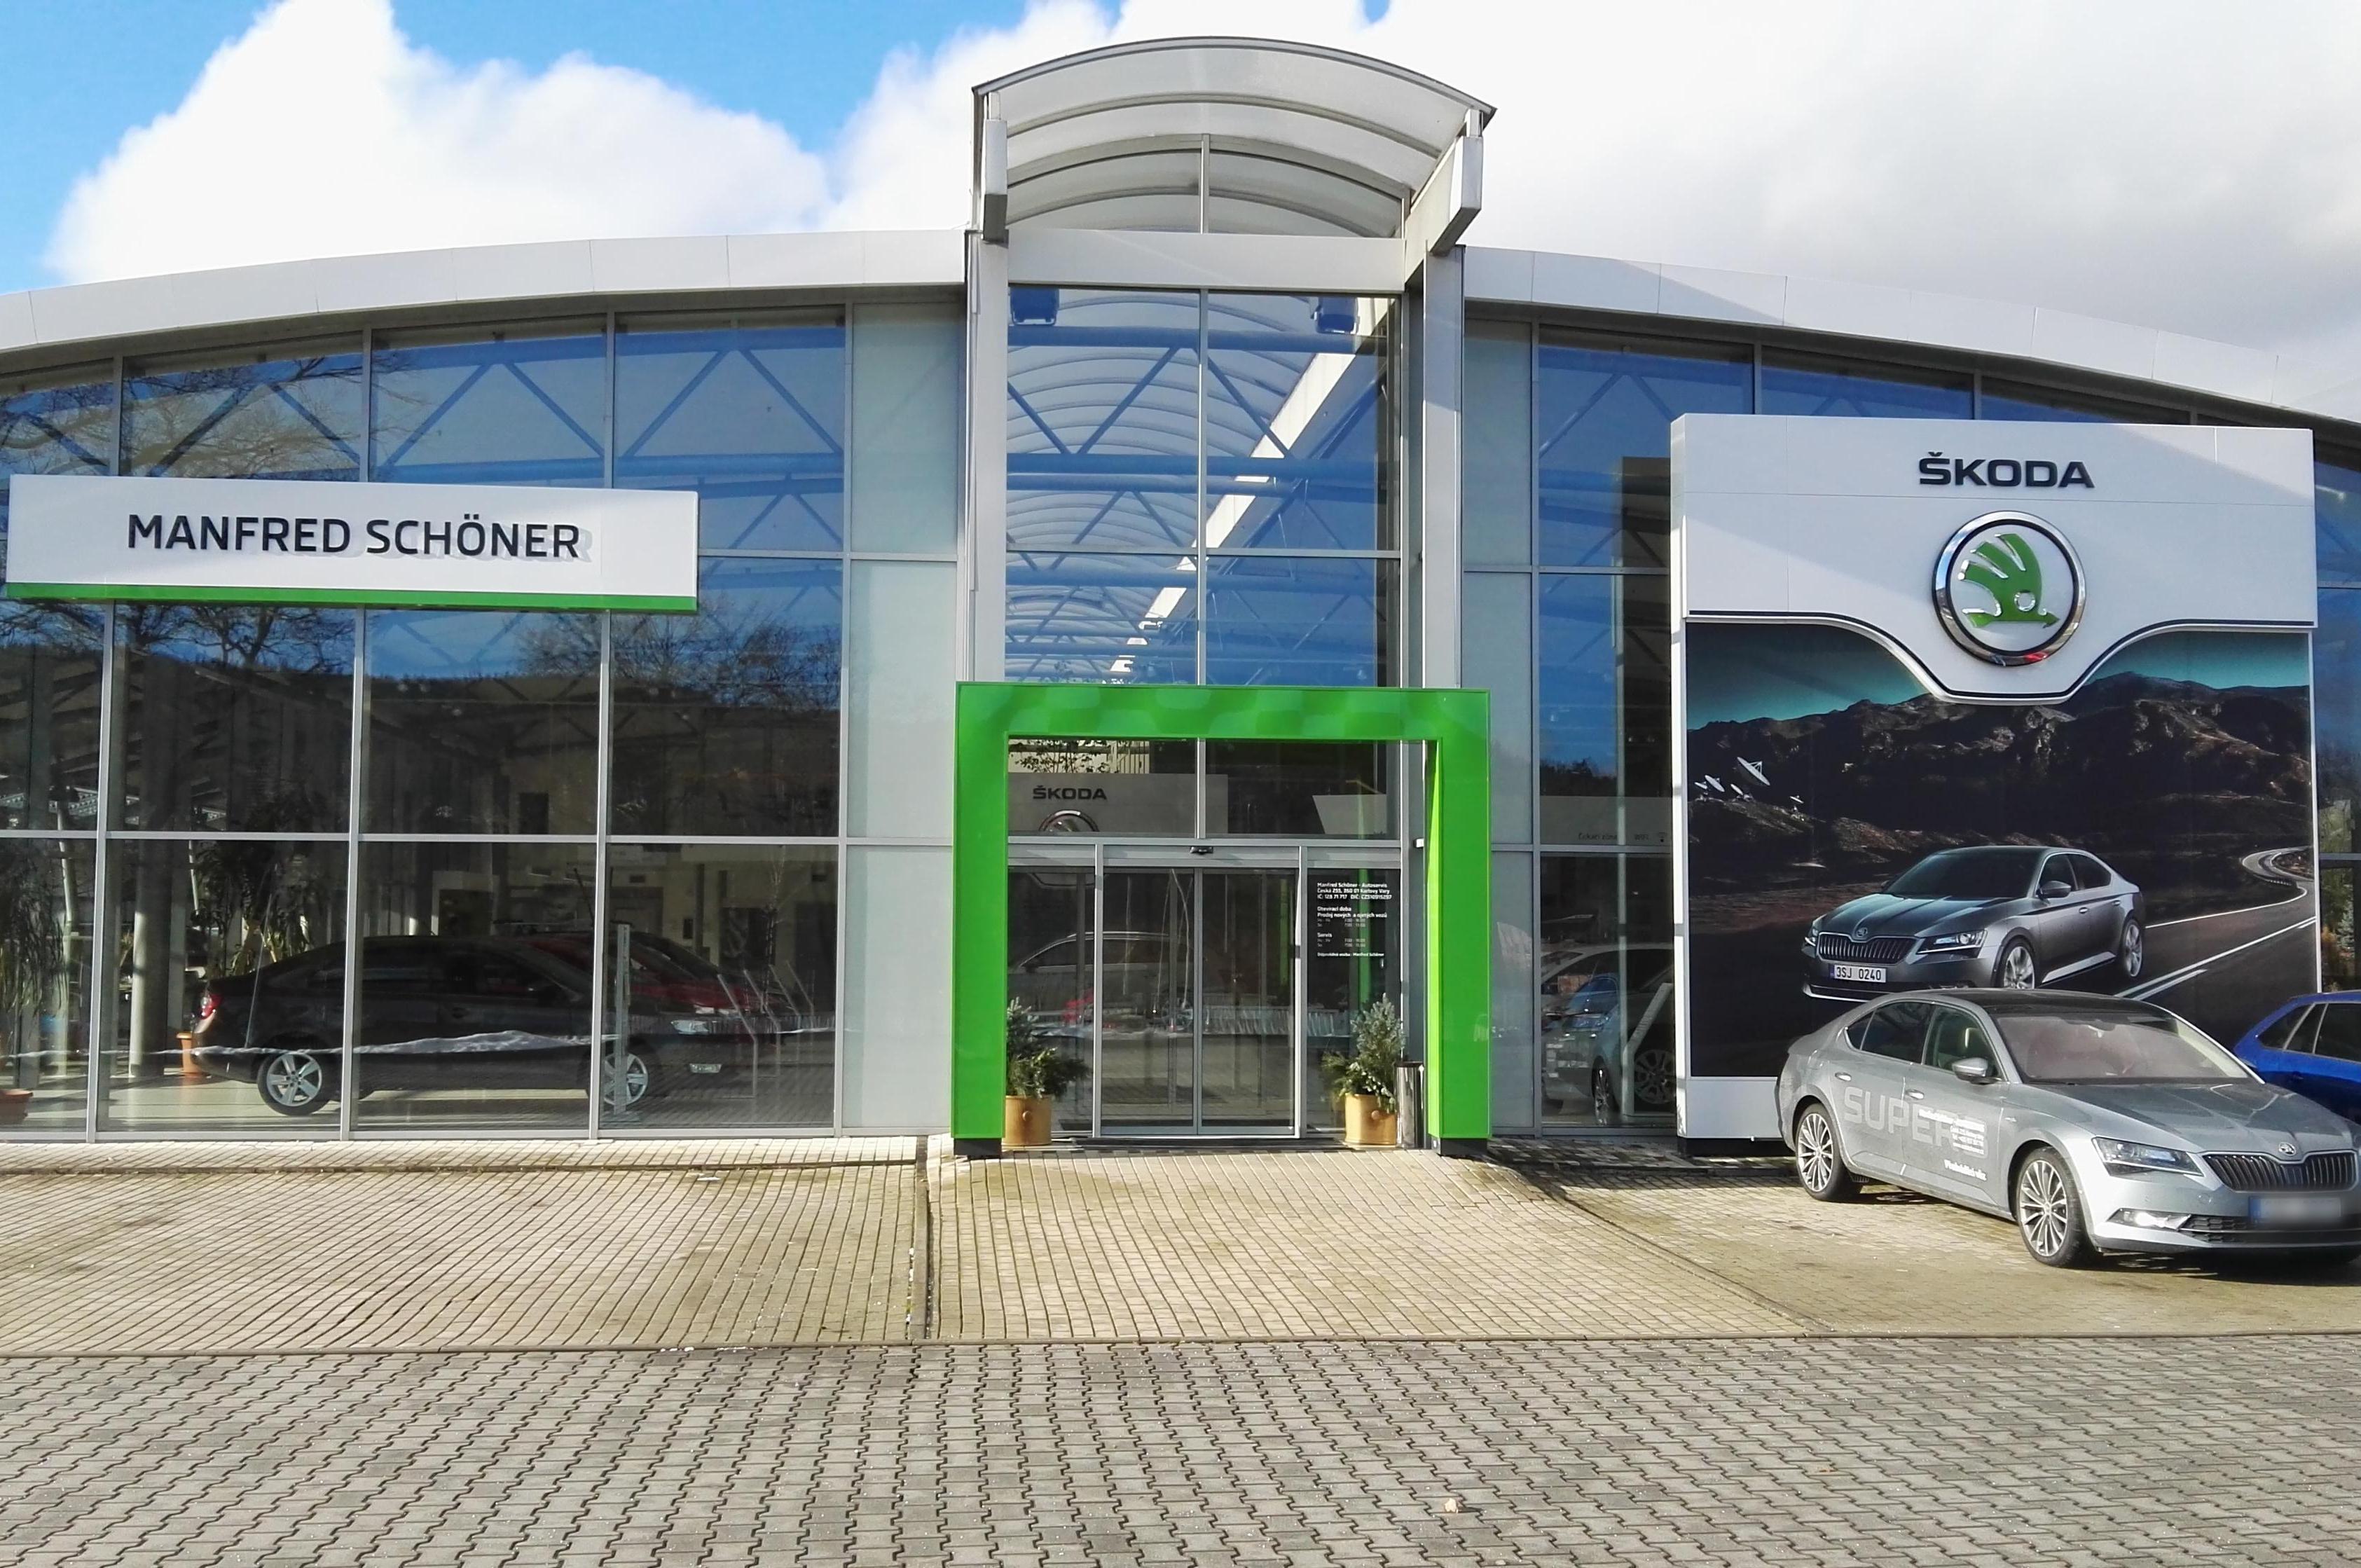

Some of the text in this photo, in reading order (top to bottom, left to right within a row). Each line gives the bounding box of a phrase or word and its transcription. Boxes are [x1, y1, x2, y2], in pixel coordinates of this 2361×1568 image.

[1918, 451, 2095, 489] ŠKODA
[128, 513, 580, 558] MANFRED SCHÖNER
[1032, 785, 1108, 800] ŠKODA
[1836, 966, 1882, 981] 3SJ 0240
